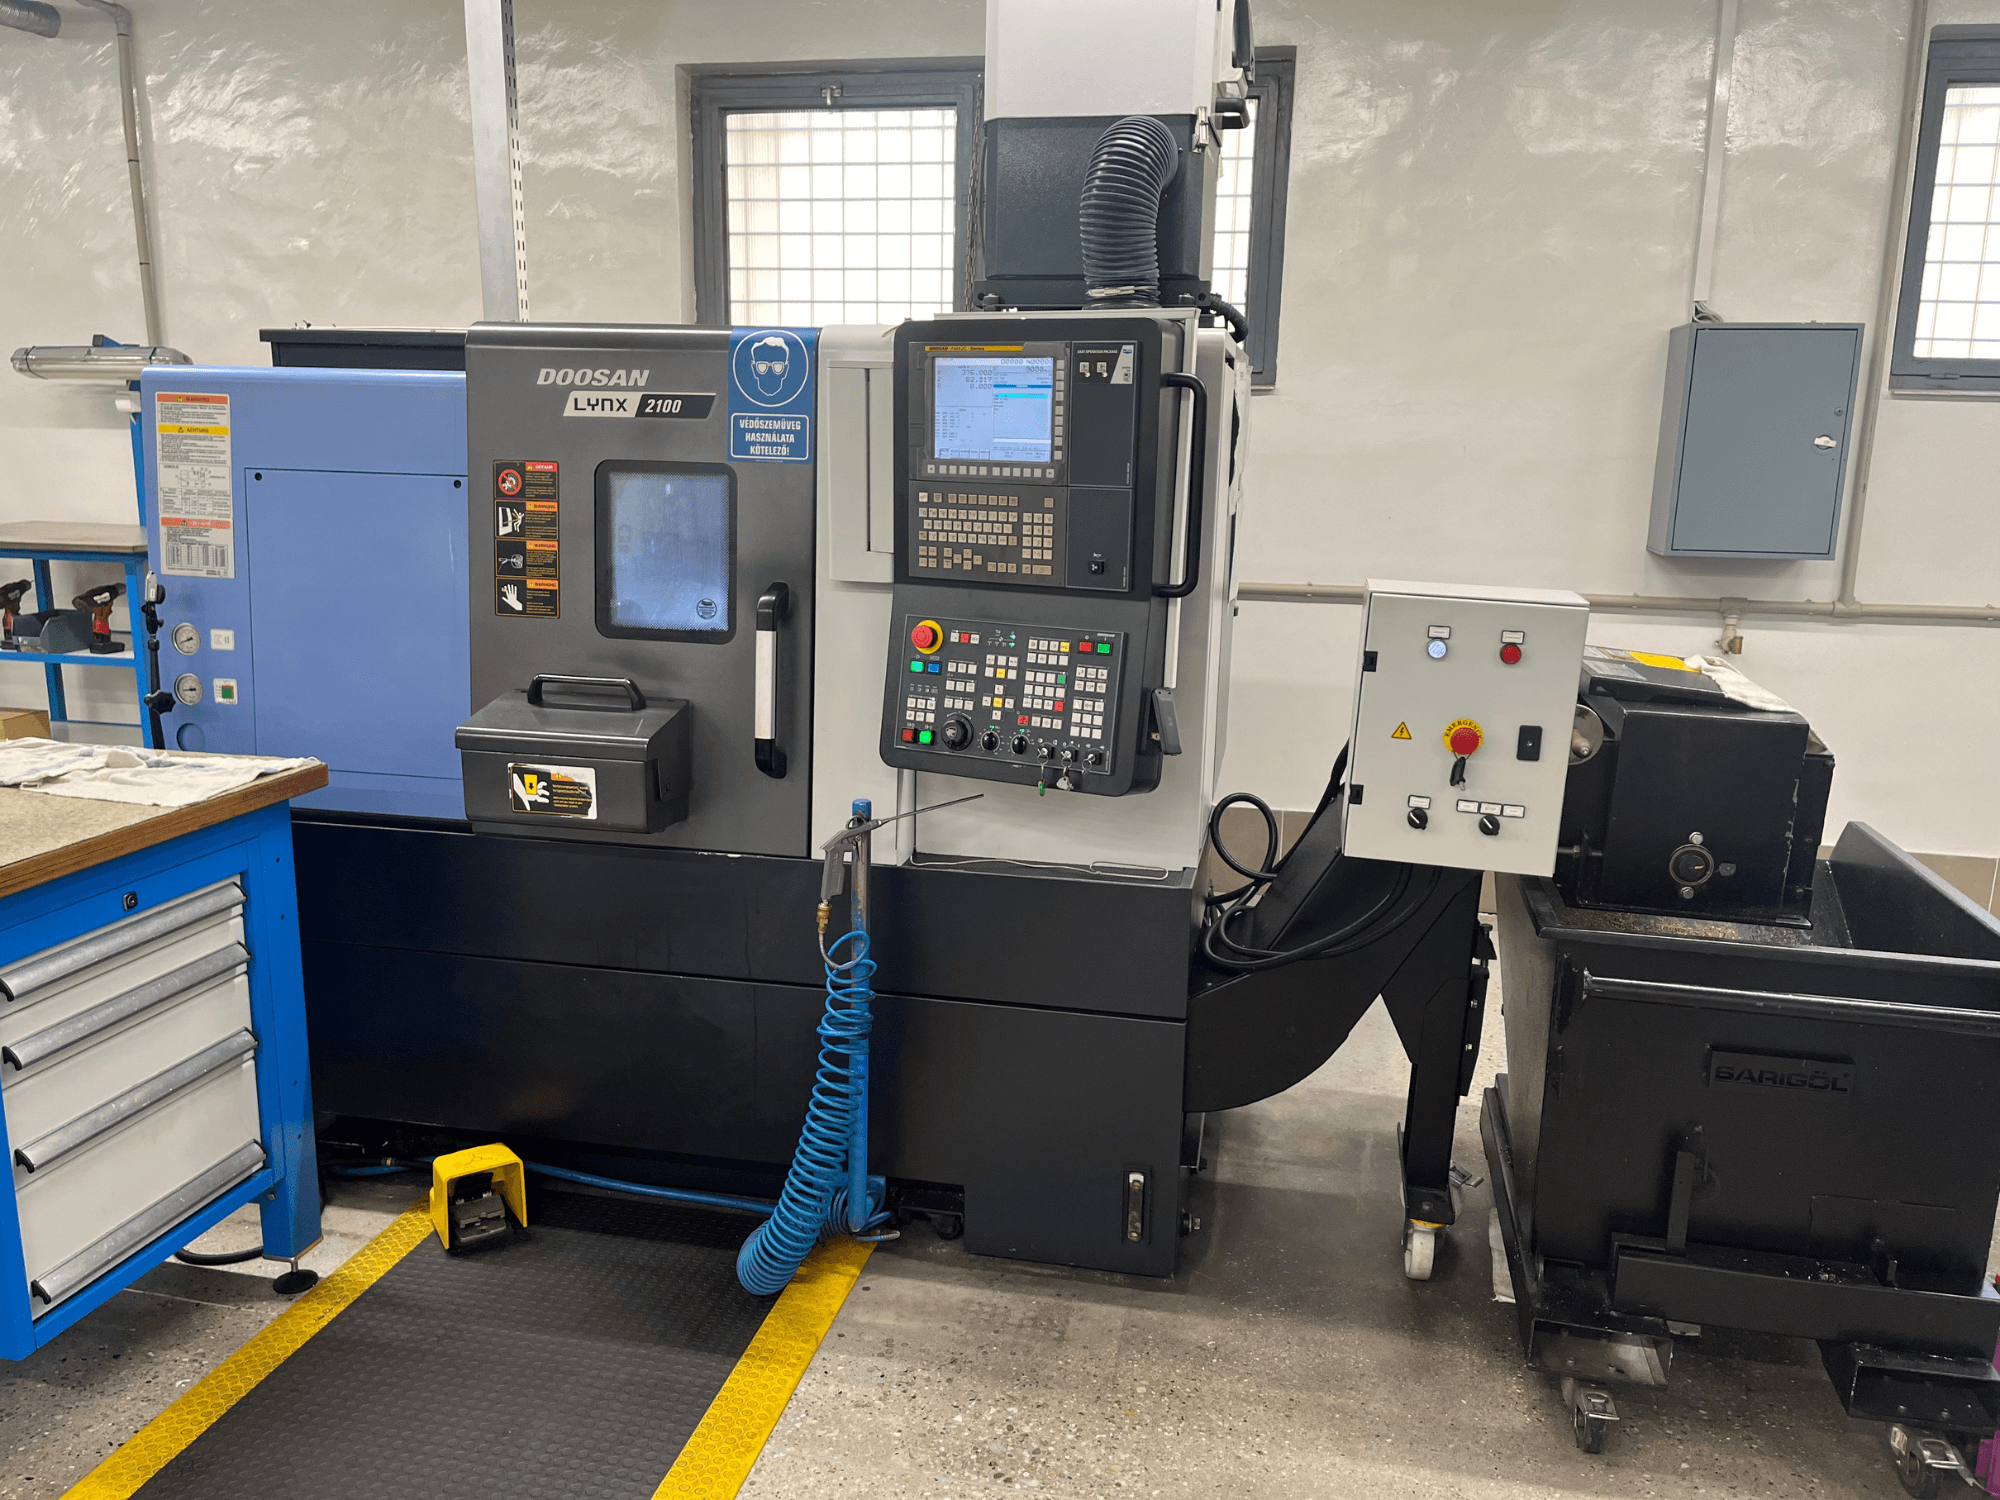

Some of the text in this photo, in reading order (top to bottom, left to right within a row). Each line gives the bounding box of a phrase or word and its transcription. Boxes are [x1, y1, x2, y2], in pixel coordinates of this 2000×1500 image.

[537, 368, 650, 387] DOOSAN
[574, 397, 682, 413] LYNX 2100
[740, 416, 801, 430] VÉDŐSZEMÜVEG
[745, 431, 795, 443] HASZNÁLATA
[750, 444, 790, 456] KÖTELEZŐ!
[1715, 1065, 1848, 1092] SARIGÖL
